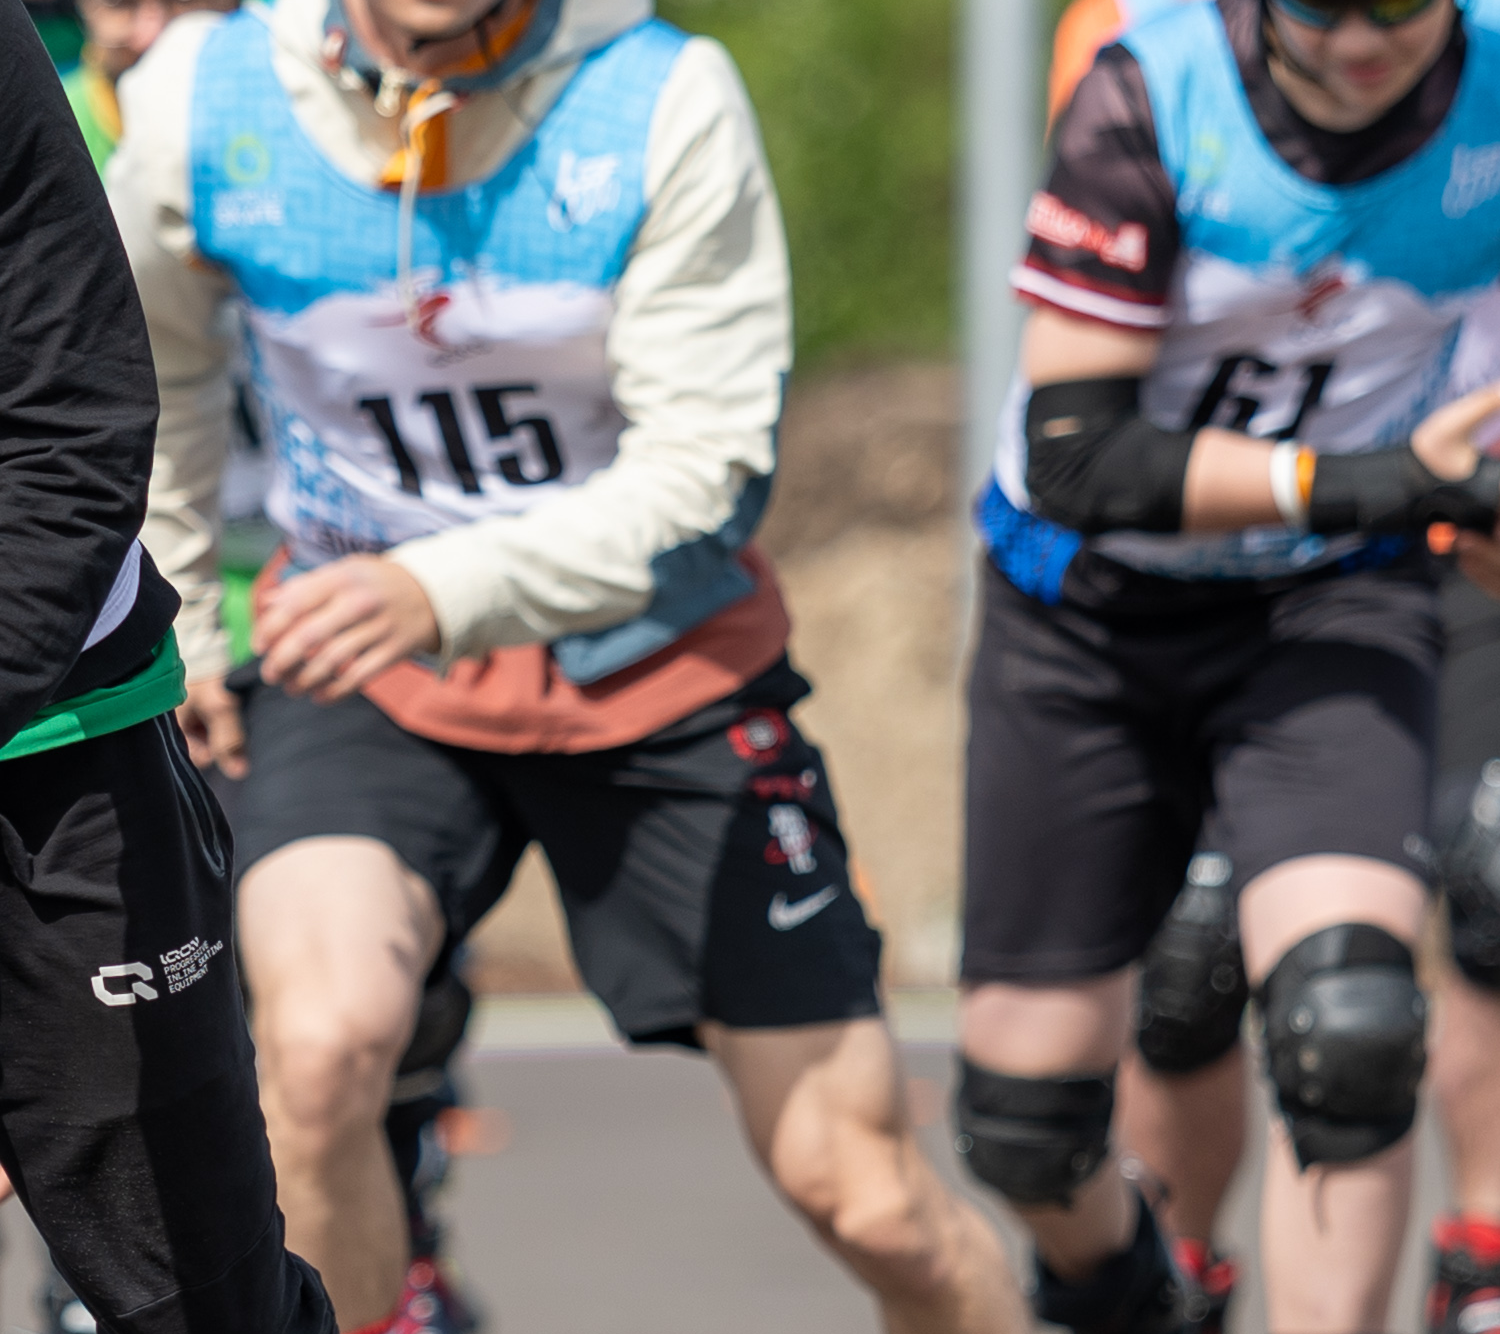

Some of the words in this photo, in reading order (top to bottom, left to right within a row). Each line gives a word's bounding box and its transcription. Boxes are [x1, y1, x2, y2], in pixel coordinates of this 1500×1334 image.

[357, 383, 565, 496] 115
[163, 940, 209, 975] PROGRESSIVE
[166, 964, 197, 984] INLINE
[198, 940, 224, 967] SKATING
[168, 964, 209, 994] EQUIPMENT
